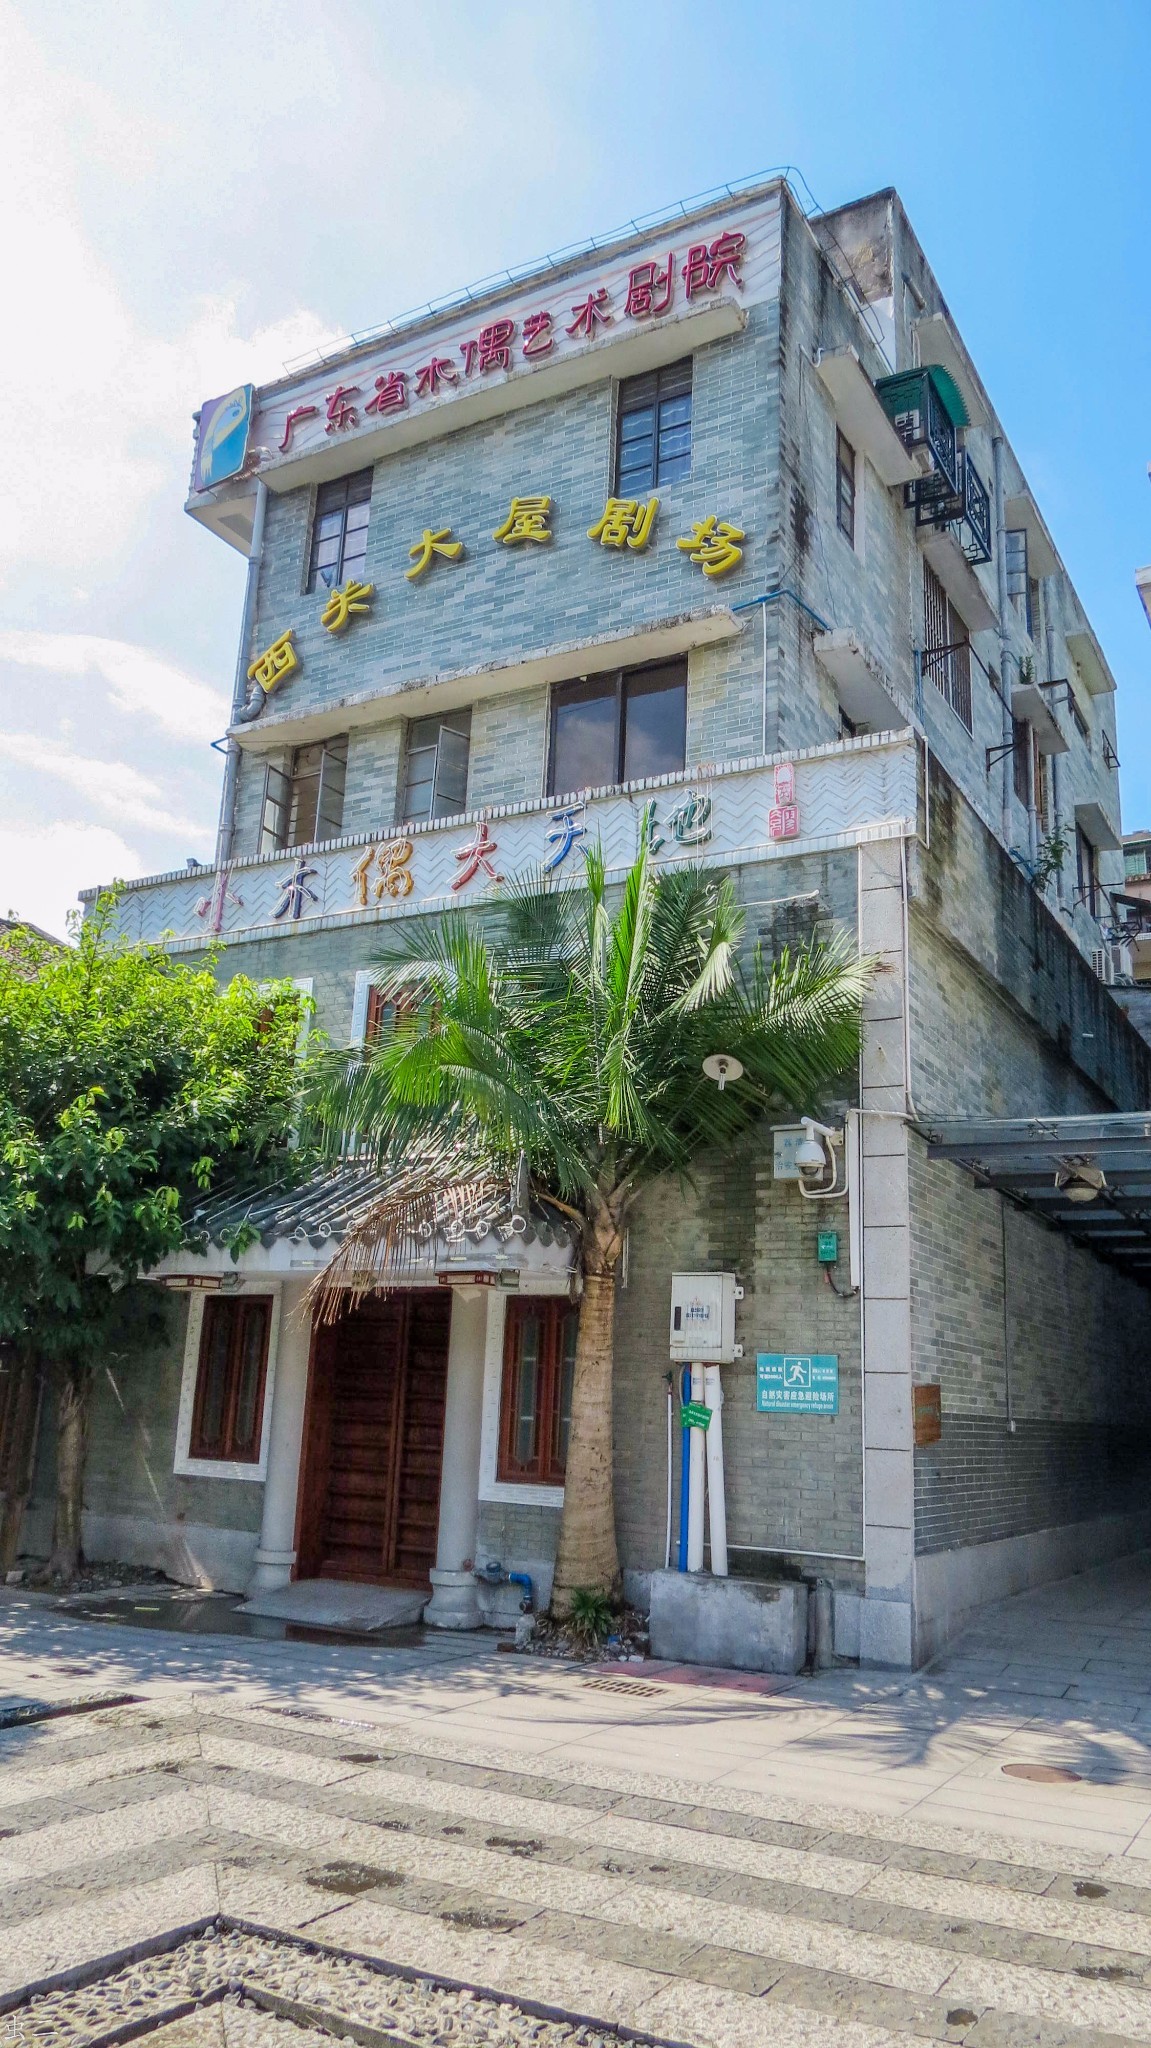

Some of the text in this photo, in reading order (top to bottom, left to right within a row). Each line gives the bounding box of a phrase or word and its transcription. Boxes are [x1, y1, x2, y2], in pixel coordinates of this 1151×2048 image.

[278, 231, 748, 452] 广东省木偶艺术剧院
[247, 496, 747, 693] 西关大屋剧场
[193, 788, 713, 933] 小木偶大天地
